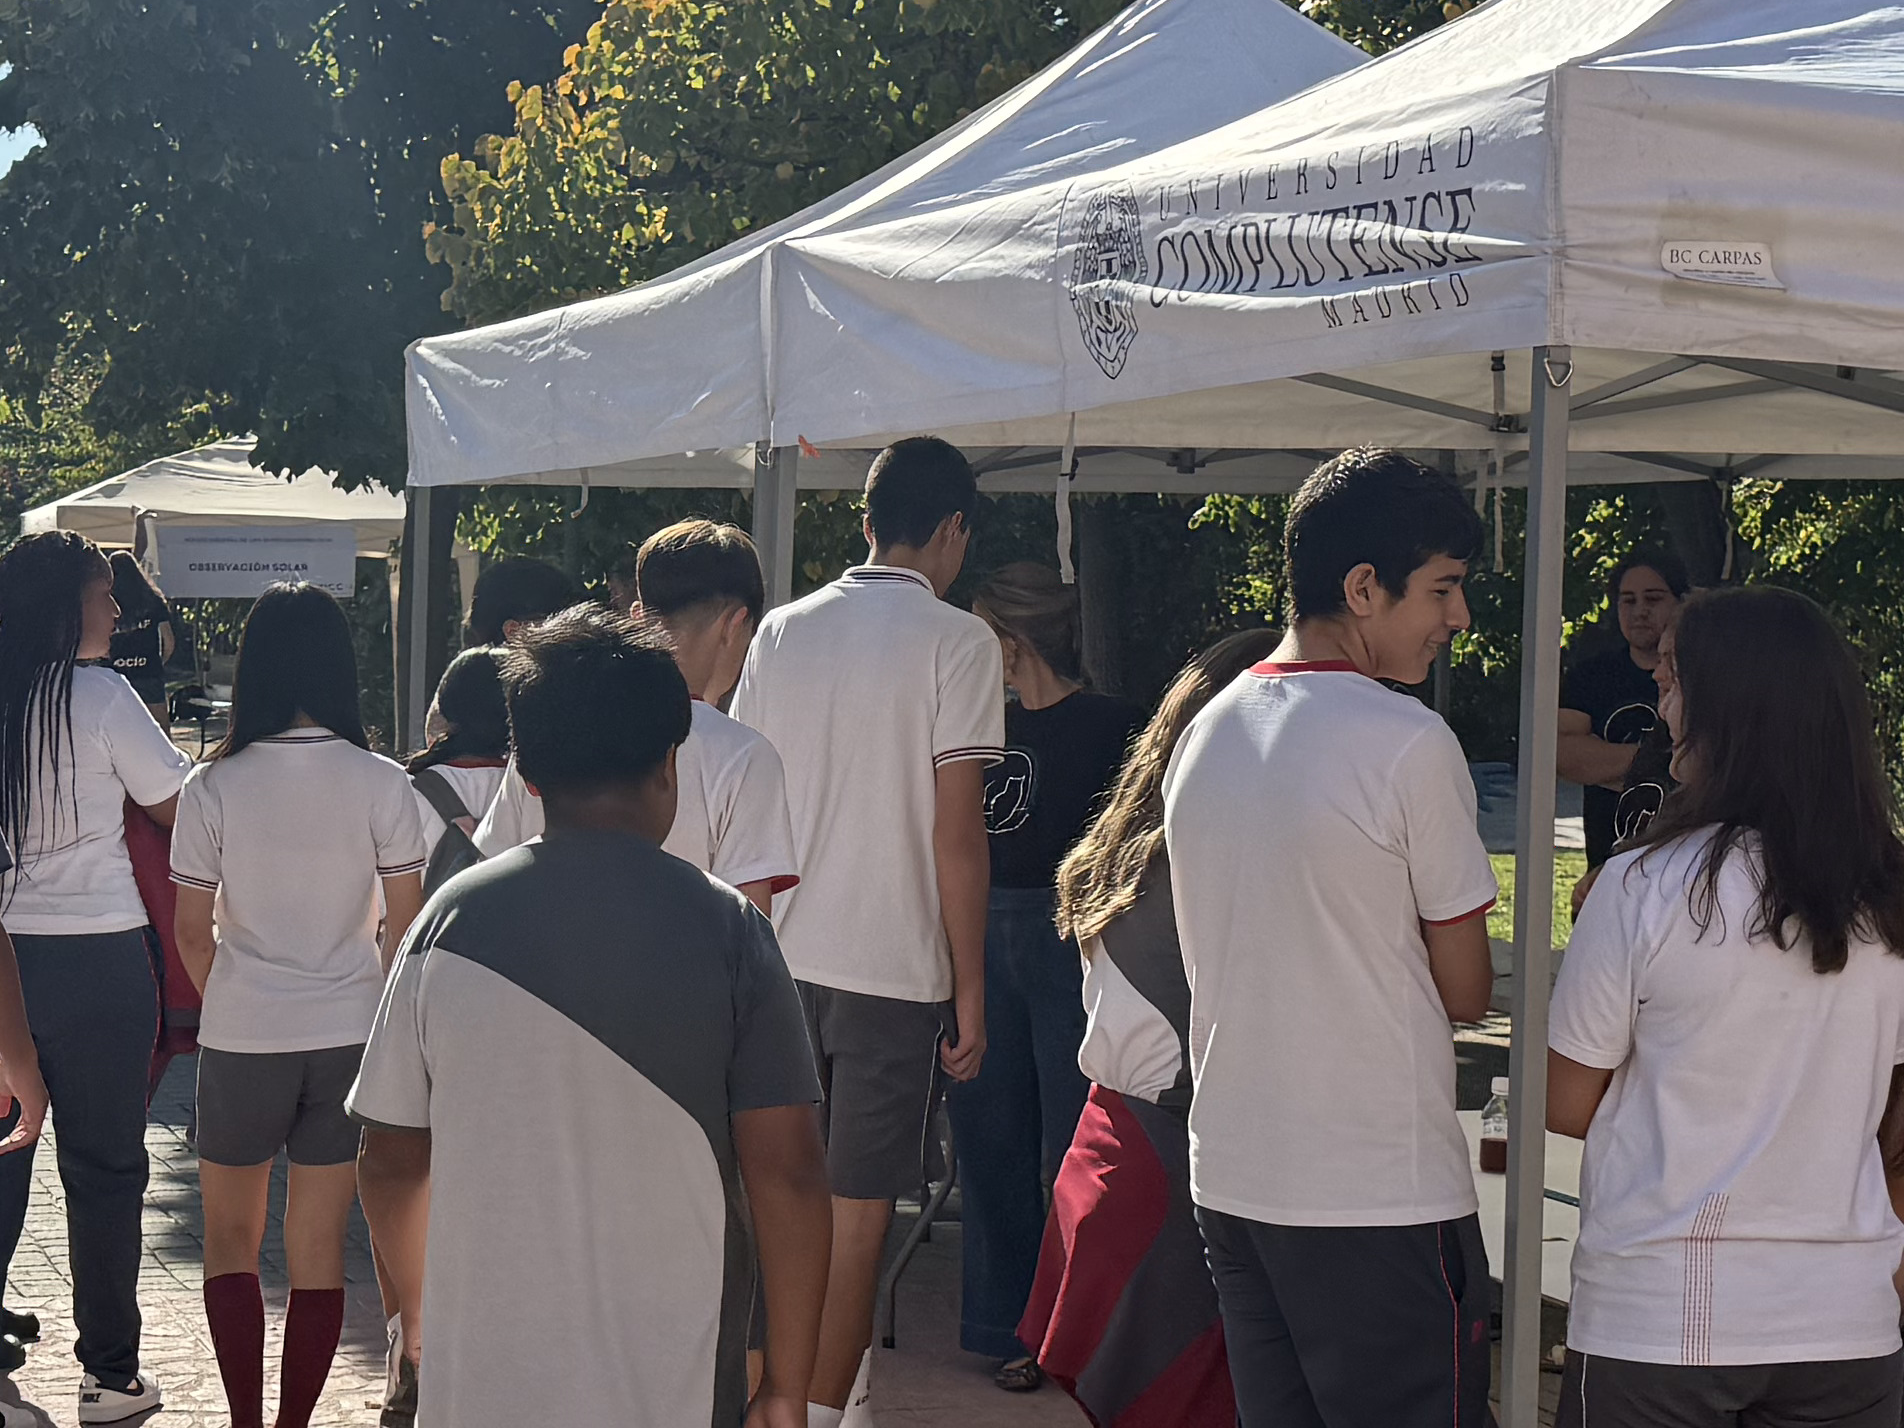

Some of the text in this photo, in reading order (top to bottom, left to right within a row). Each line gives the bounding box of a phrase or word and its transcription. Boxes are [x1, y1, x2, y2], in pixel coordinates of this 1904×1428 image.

[1157, 126, 1475, 221] UNIVERSIDAD
[1150, 187, 1483, 308] COMPLUTENSE
[1669, 249, 1762, 265] BC CARPAS
[272, 562, 308, 572] SOLAR
